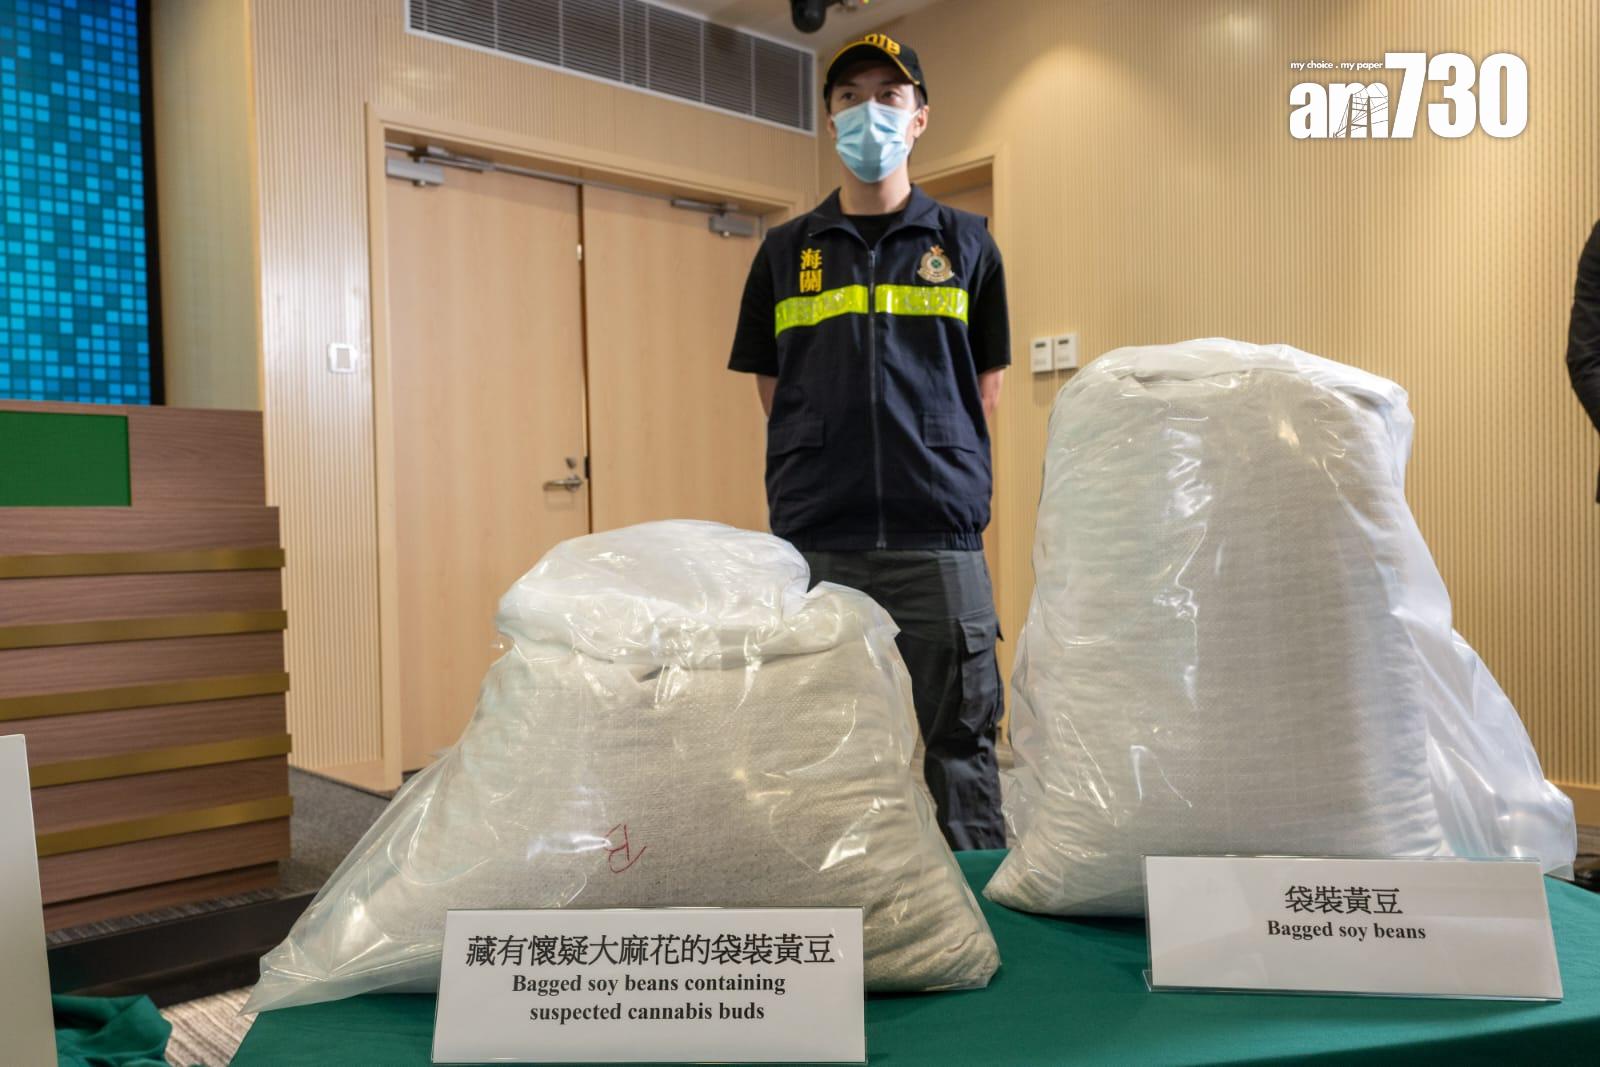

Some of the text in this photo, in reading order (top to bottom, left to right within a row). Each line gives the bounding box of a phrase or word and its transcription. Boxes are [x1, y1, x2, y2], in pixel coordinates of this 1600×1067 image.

[1267, 920, 1426, 942] Bagged soy beans
[512, 974, 786, 996] Bagged soy beans containing
[529, 1002, 765, 1025] suspected cannabis buds
